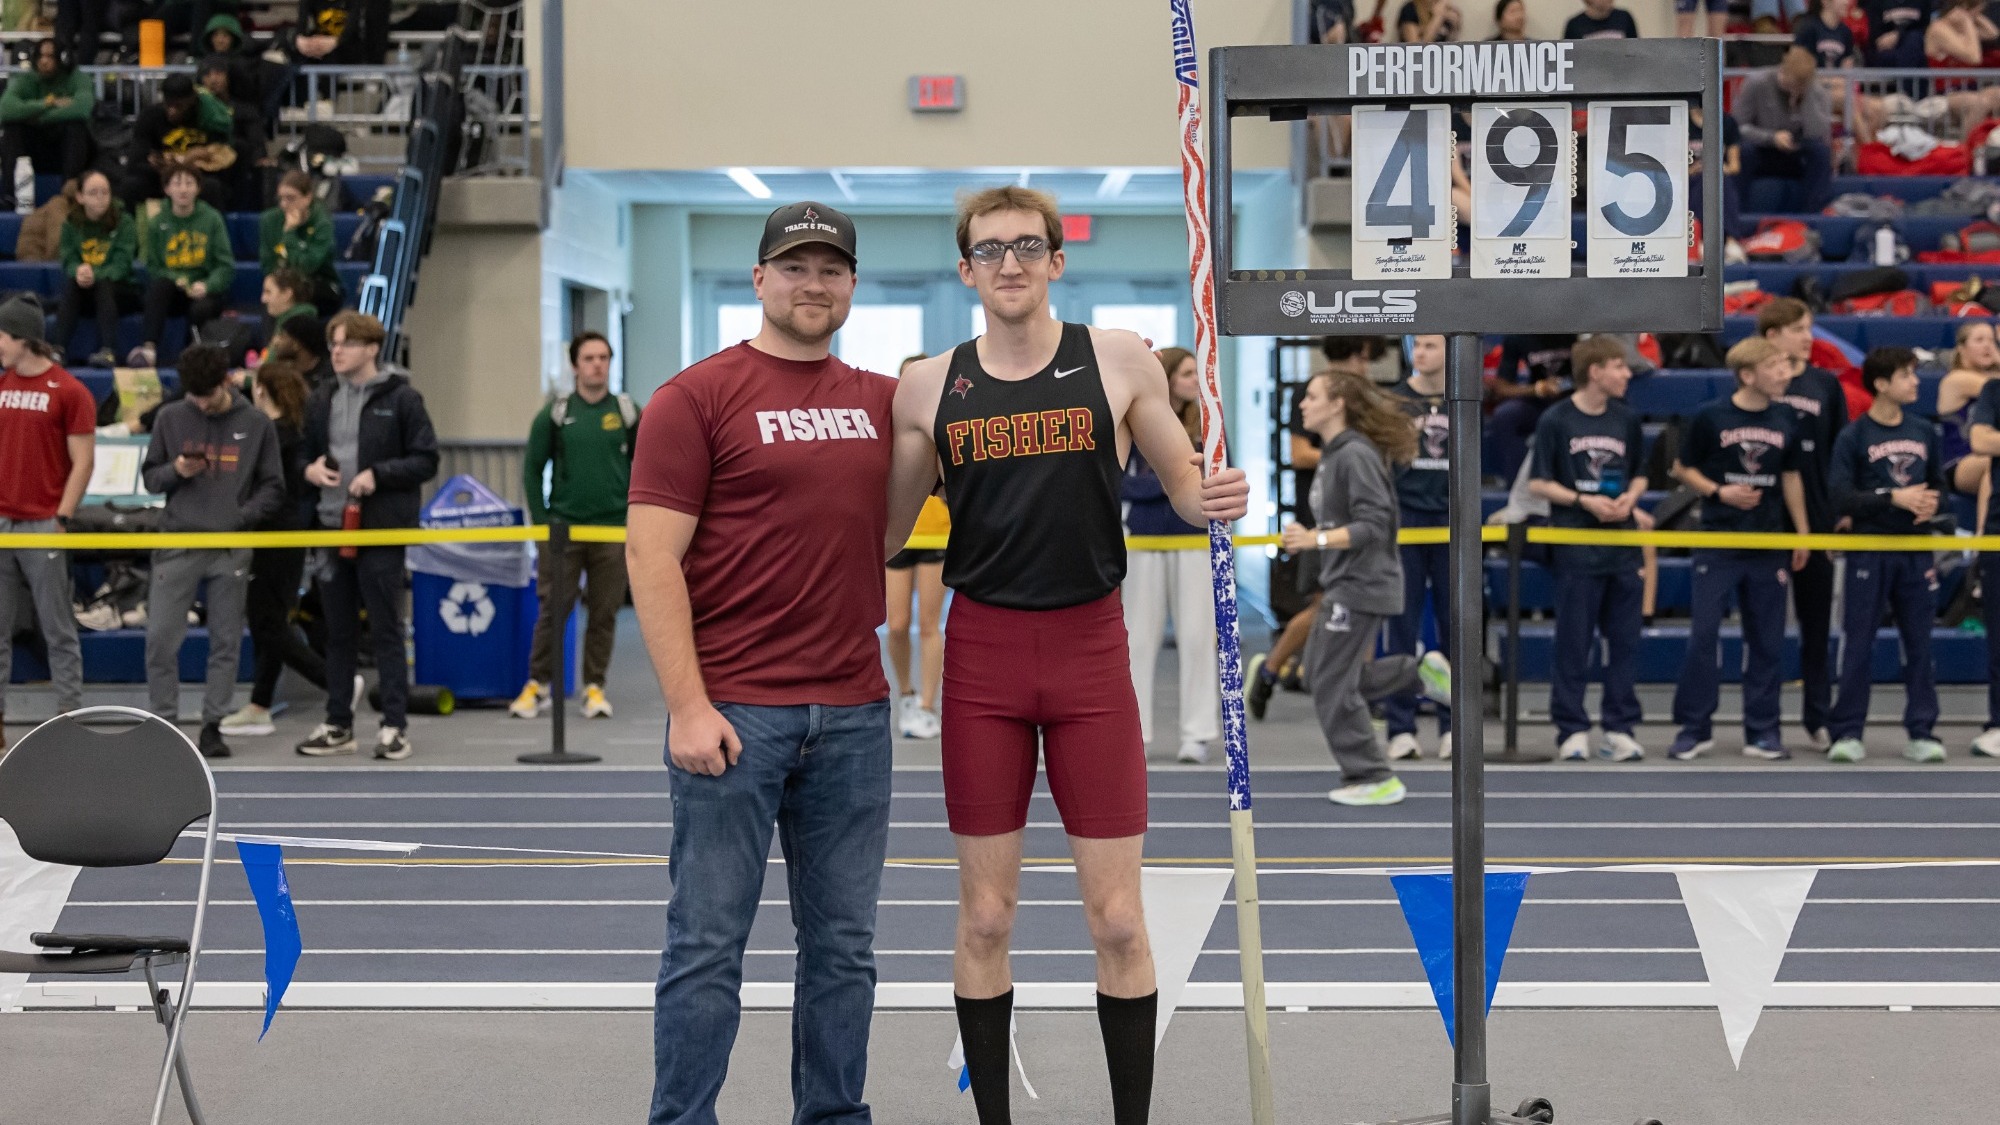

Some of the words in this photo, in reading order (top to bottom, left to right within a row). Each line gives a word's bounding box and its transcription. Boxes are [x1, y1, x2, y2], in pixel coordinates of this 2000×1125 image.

[1348, 42, 1574, 96] PERFORMANCE
[1188, 103, 1196, 121] SIDE
[1189, 124, 1197, 144] SOFT
[1365, 109, 1436, 238] 4
[1485, 108, 1559, 237] 9
[1600, 106, 1674, 236] 5
[784, 223, 809, 233] TRACK
[817, 223, 838, 234] FIELD
[1307, 290, 1417, 314] UCS
[0, 390, 50, 413] FISHER
[755, 408, 879, 445] FISHER
[946, 407, 1096, 466] FISHER
